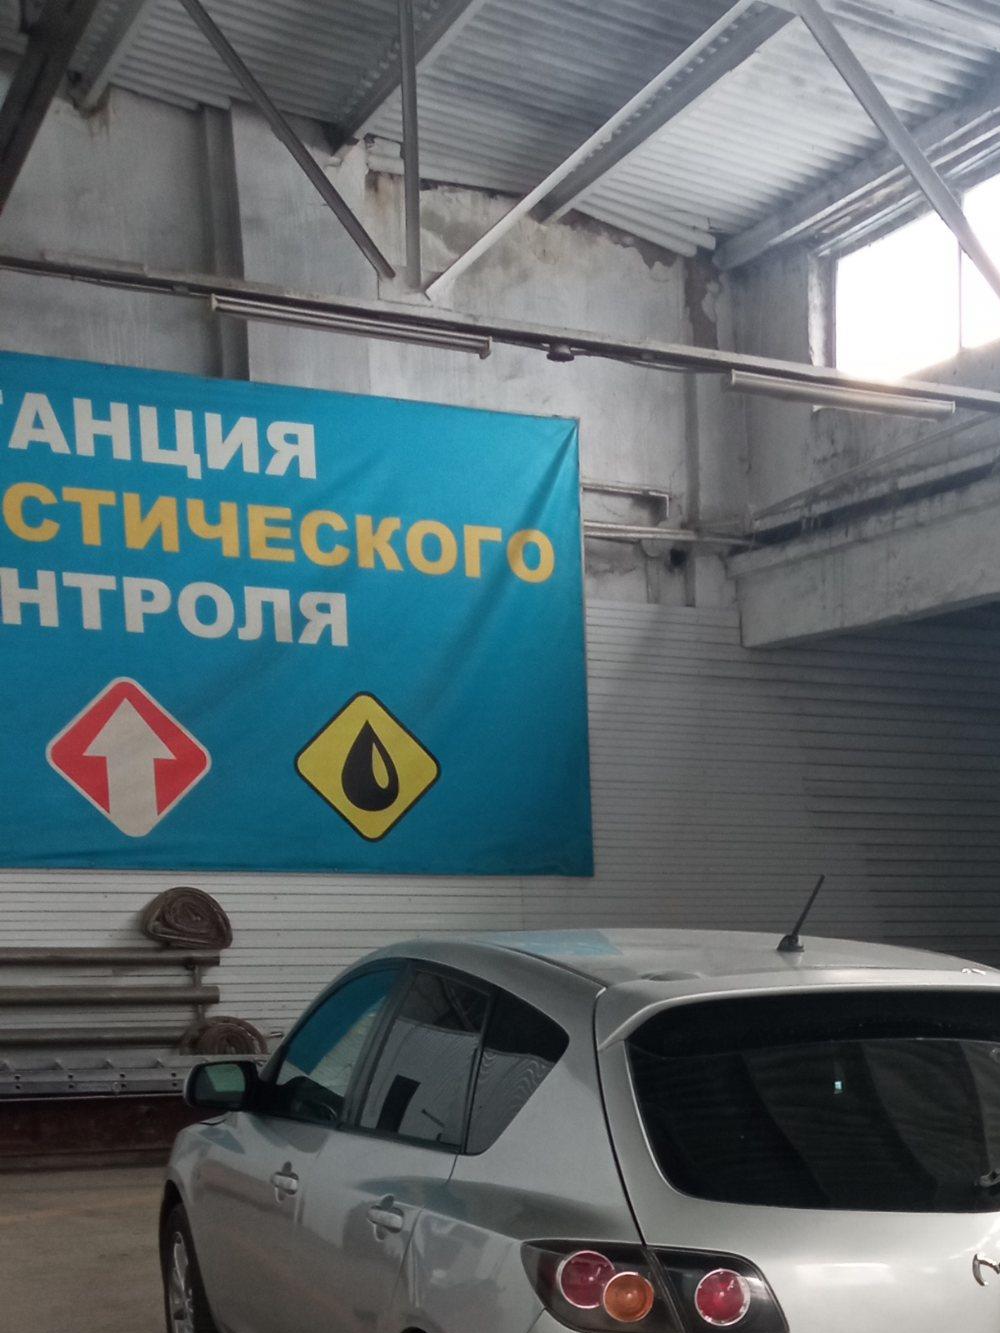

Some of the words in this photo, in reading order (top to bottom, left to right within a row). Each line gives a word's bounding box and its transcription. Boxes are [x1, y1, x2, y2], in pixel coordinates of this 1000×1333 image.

[0, 390, 317, 479] АНЦИЯ
[3, 482, 555, 583] СТИЧЕСКОГО
[0, 567, 348, 647] НТРОЛЯ
